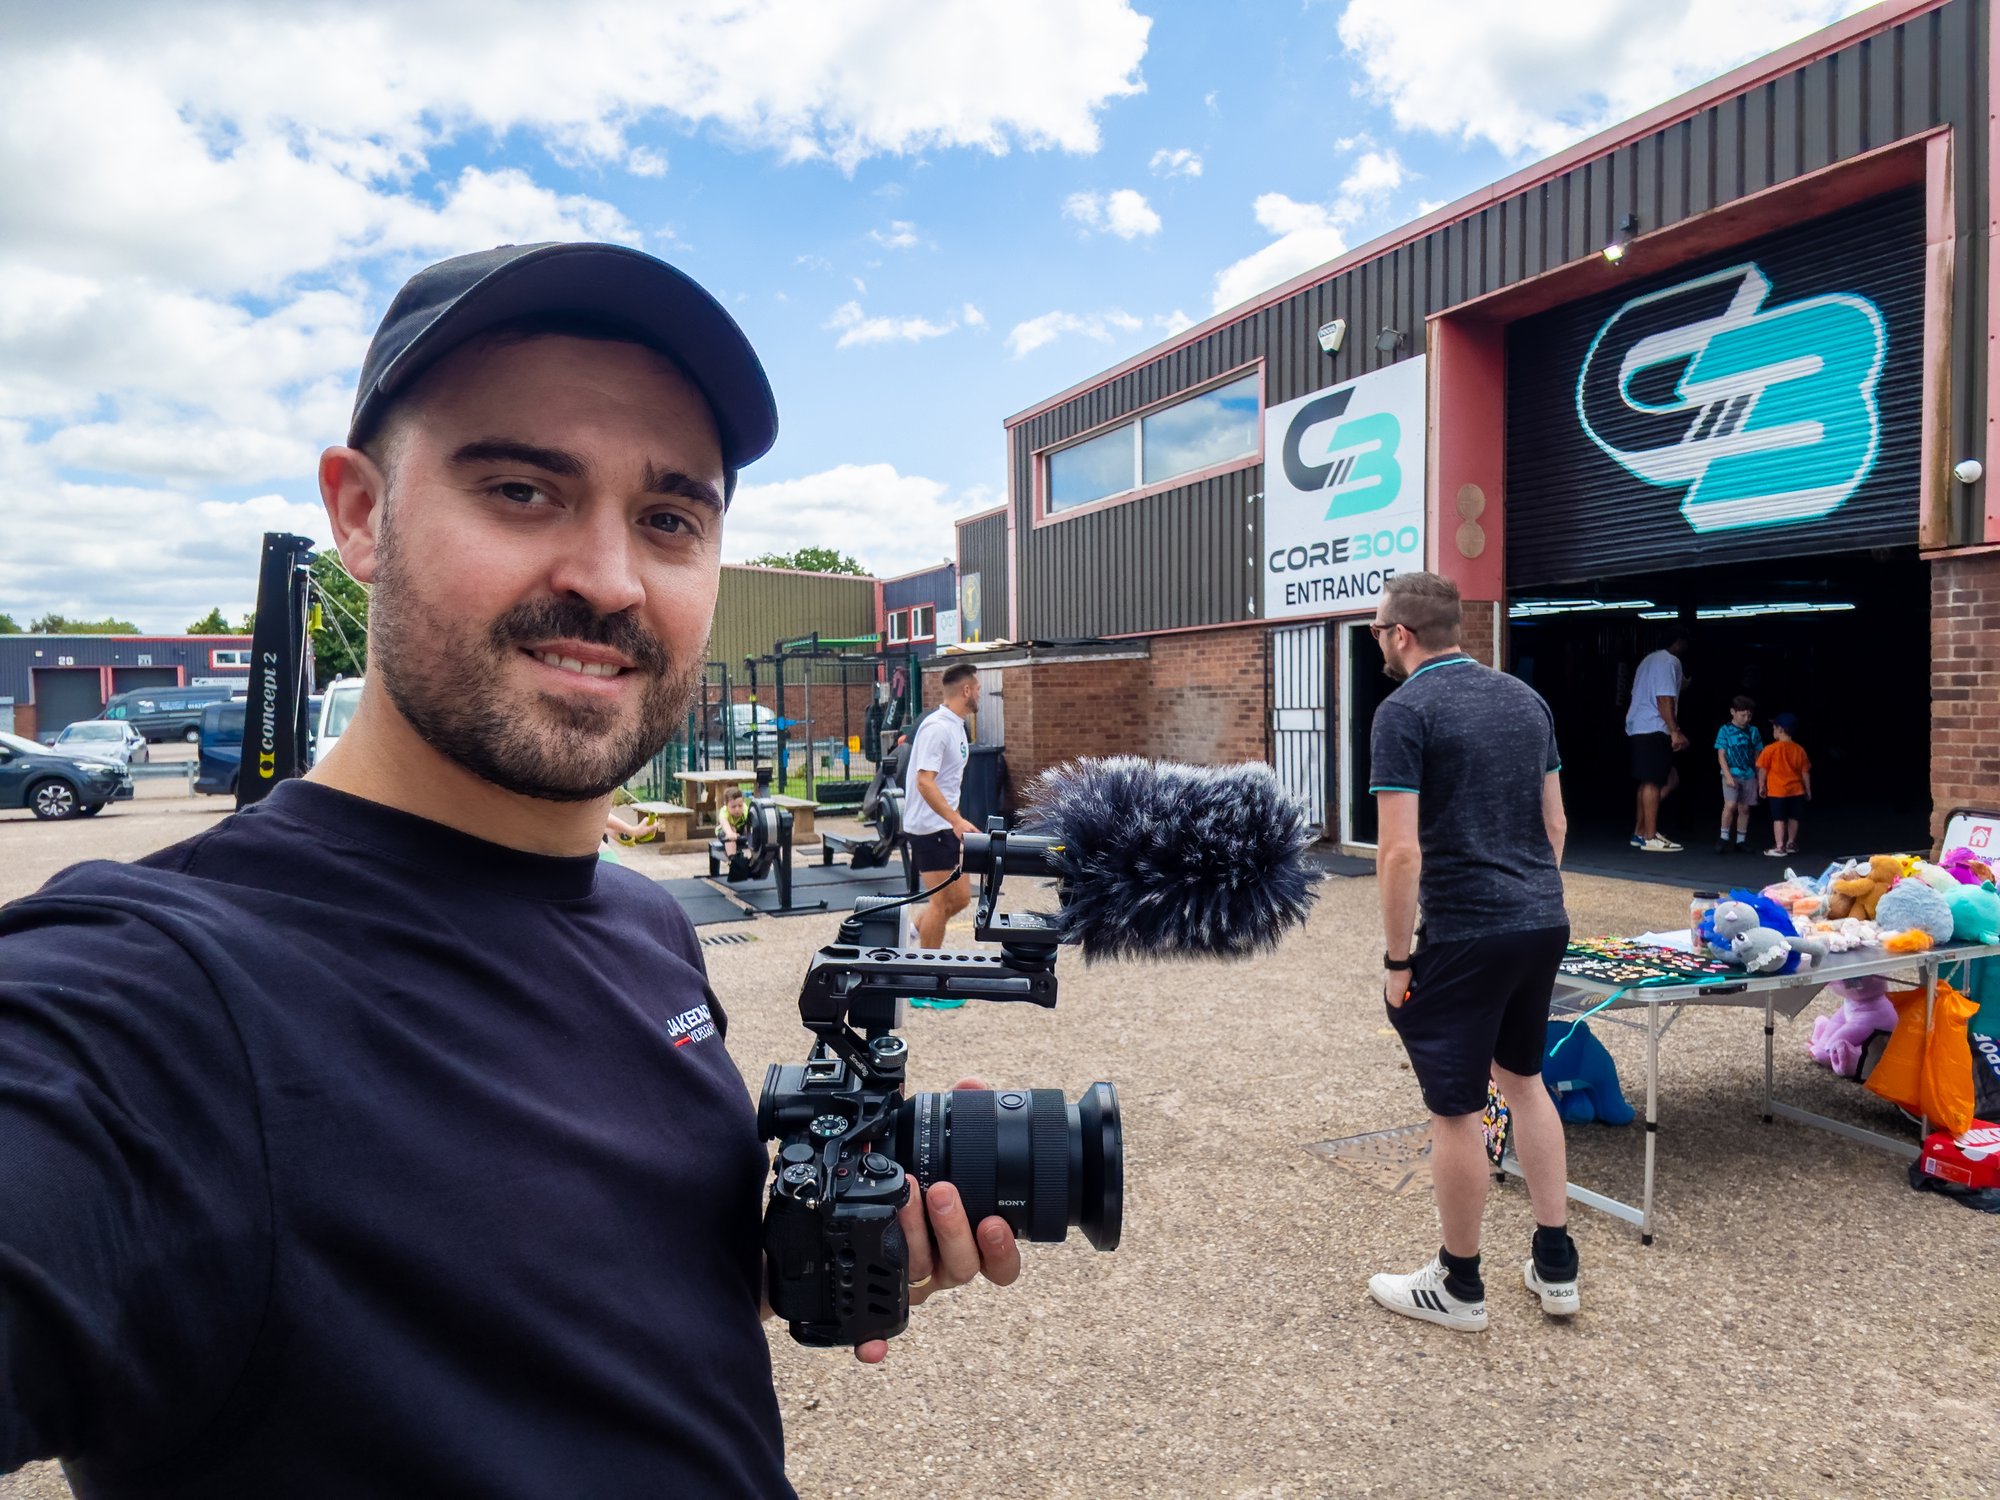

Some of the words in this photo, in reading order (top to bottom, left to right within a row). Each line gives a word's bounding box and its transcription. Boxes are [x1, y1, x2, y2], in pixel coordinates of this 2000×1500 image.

[1268, 525, 1420, 574] CORE300
[261, 667, 278, 750] concept
[1956, 1127, 2000, 1145] NIK
[998, 1199, 1027, 1207] SONY
